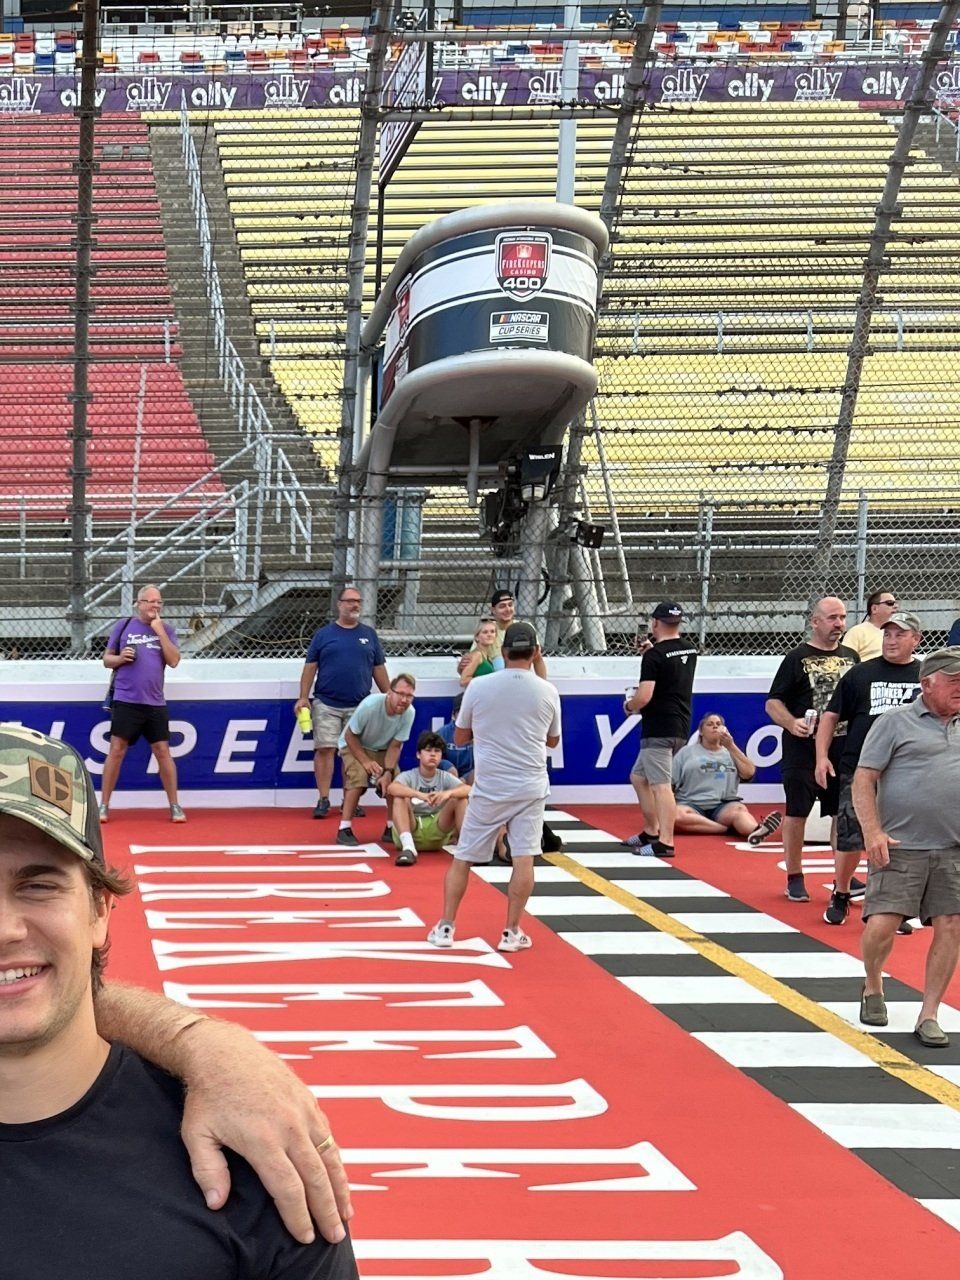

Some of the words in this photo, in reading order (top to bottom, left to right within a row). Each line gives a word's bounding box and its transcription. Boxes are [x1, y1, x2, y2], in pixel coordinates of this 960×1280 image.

[60, 82, 107, 107] aly
[126, 77, 172, 110] ally
[191, 81, 238, 109] ally
[461, 76, 508, 104] ally
[594, 75, 624, 99] all
[661, 69, 709, 102] ally
[727, 73, 774, 101] ally
[794, 68, 842, 101] ally
[862, 71, 909, 99] ally
[503, 277, 541, 289] 400
[510, 313, 541, 323] NASCAR
[499, 326, 516, 335] CUP
[515, 325, 541, 335] SERIES
